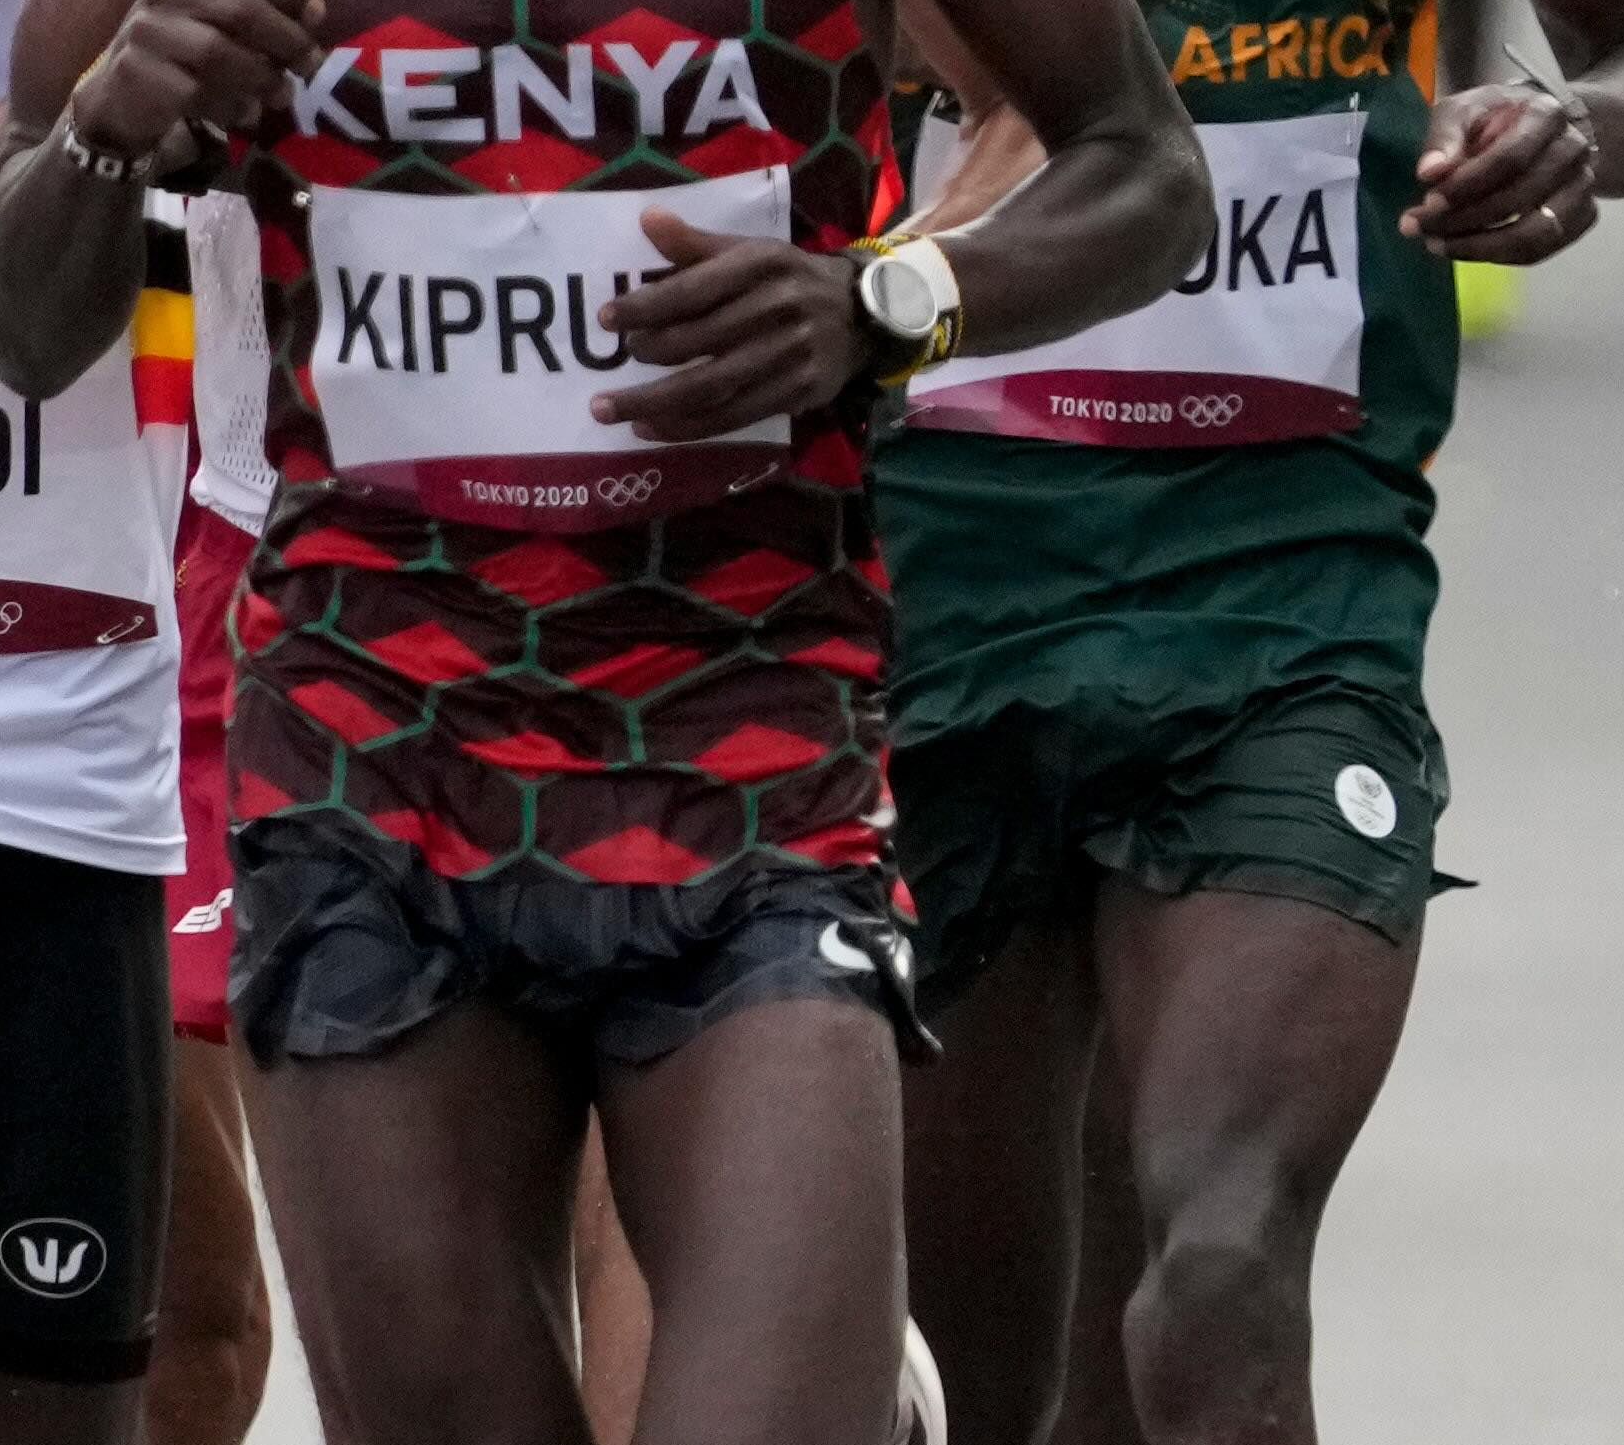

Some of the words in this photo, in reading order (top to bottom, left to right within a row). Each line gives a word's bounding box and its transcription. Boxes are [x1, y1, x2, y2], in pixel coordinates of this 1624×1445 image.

[285, 38, 774, 143] KENYA
[336, 266, 676, 374] KIPRU
[1049, 395, 1117, 422] TOKYO
[1120, 401, 1173, 423] 2020
[460, 479, 530, 506] TOKYO
[533, 485, 589, 507] 2020
